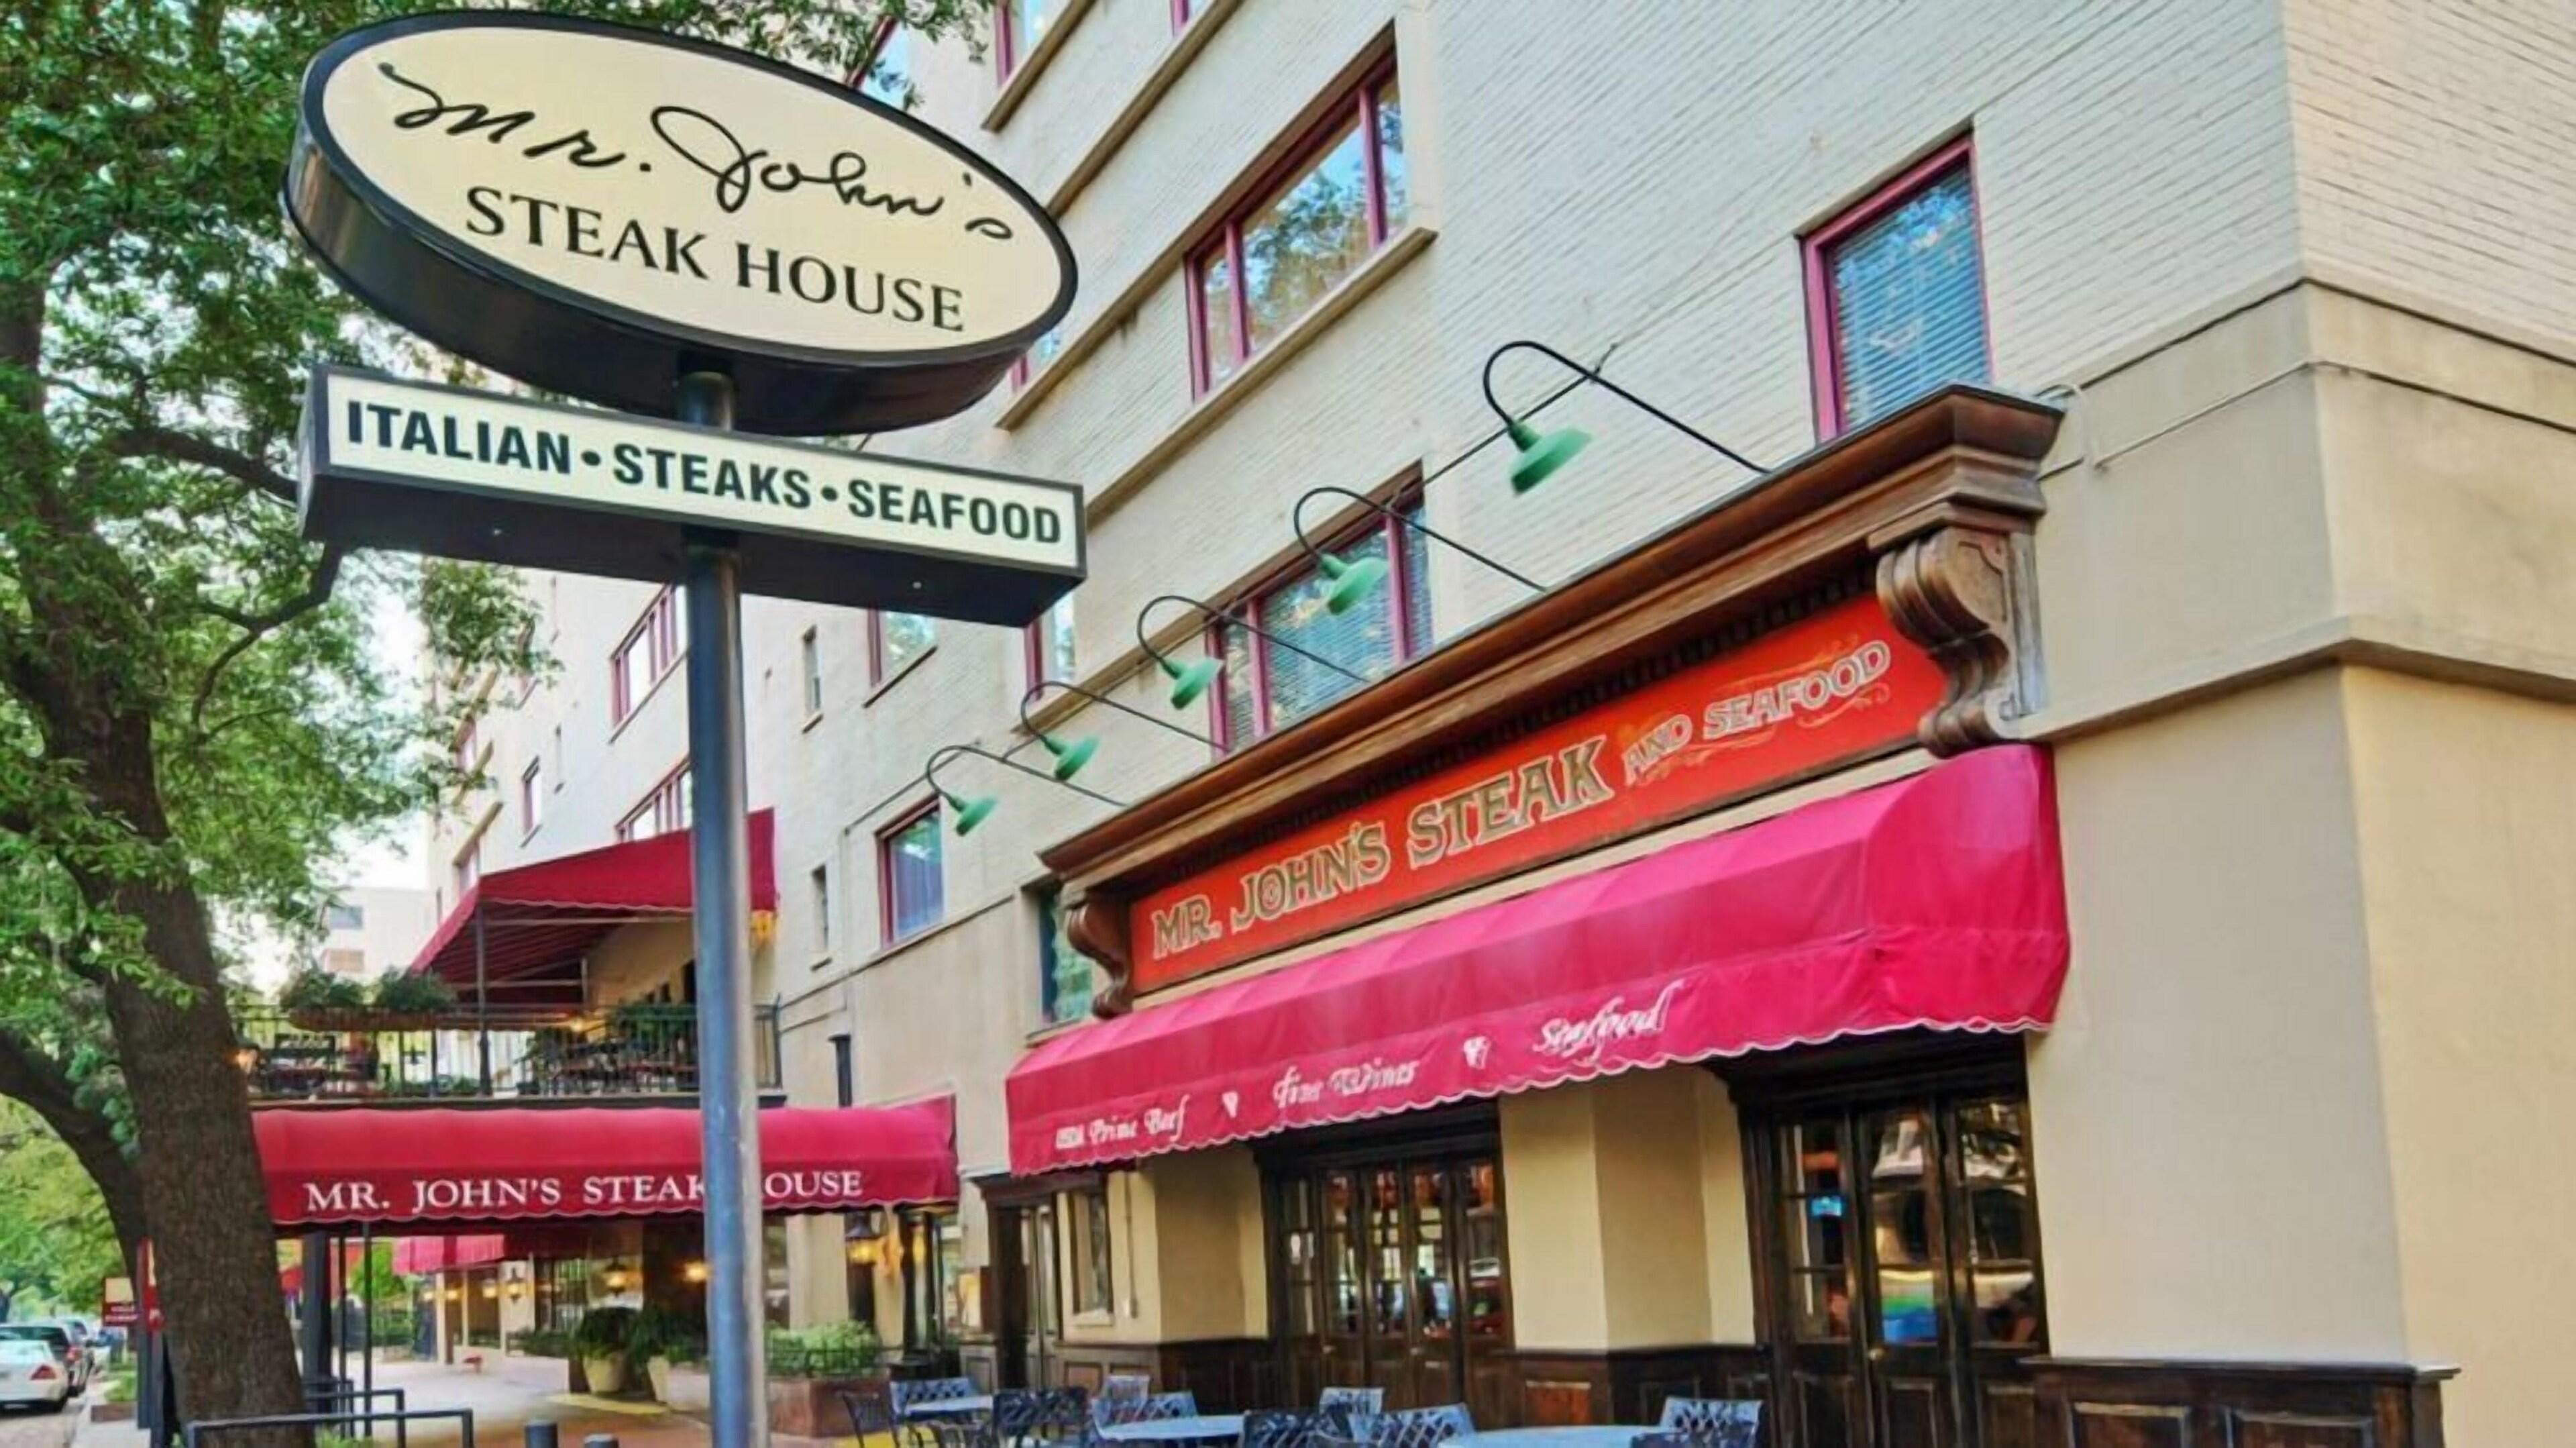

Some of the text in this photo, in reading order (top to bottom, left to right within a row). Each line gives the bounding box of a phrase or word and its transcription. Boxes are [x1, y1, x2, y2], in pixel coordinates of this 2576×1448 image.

[377, 61, 1013, 240] Mr. John's
[465, 185, 965, 333] STEAK HOUSE
[347, 401, 1061, 544] ITALIAN STEAKS SEAFOOD
[1150, 639, 1891, 960] MR. JOHN'S STEAK AND SEAFOOD
[1328, 1057, 1421, 1096] Wines
[1532, 978, 1686, 1068] Seafood
[1144, 1094, 1191, 1142] Beef
[302, 1182, 391, 1212] MR.
[412, 1177, 561, 1214] JOHN'S
[761, 1170, 863, 1198] OUSE
